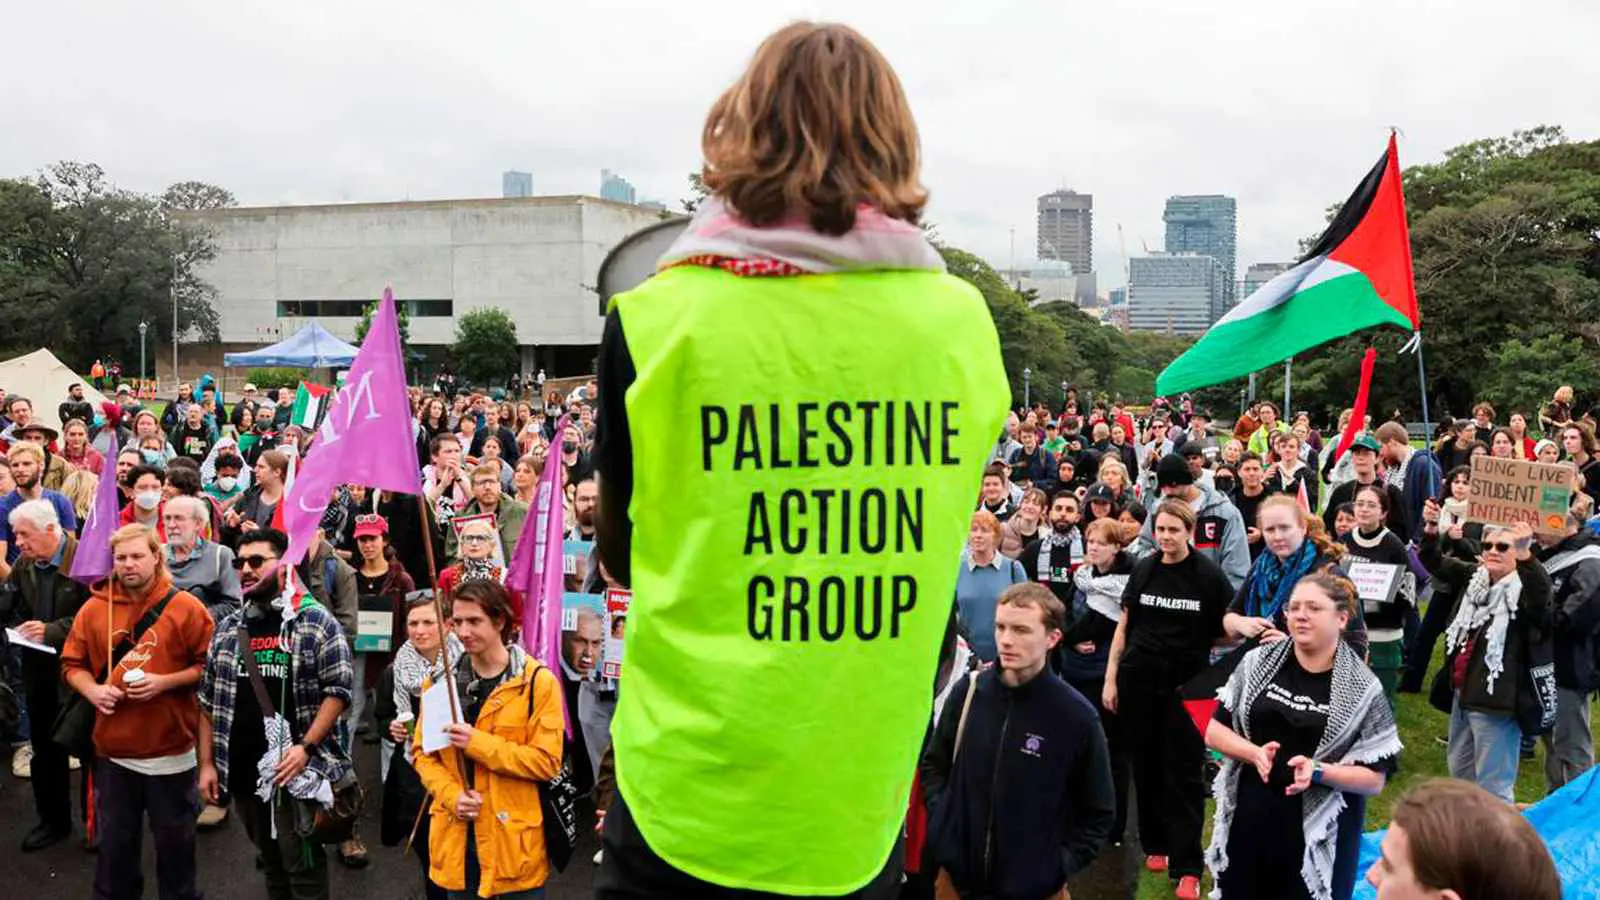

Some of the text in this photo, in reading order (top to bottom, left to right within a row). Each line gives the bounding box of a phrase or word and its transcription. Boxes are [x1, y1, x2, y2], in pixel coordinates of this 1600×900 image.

[701, 401, 961, 471] PALESTINE
[1474, 459, 1566, 484] LONG LIVE
[1470, 478, 1537, 503] STUDENT
[743, 488, 924, 555] ACTION
[1468, 502, 1540, 527] INTIFADA
[747, 574, 918, 642] GROUP
[1156, 596, 1201, 611] PALESTINE
